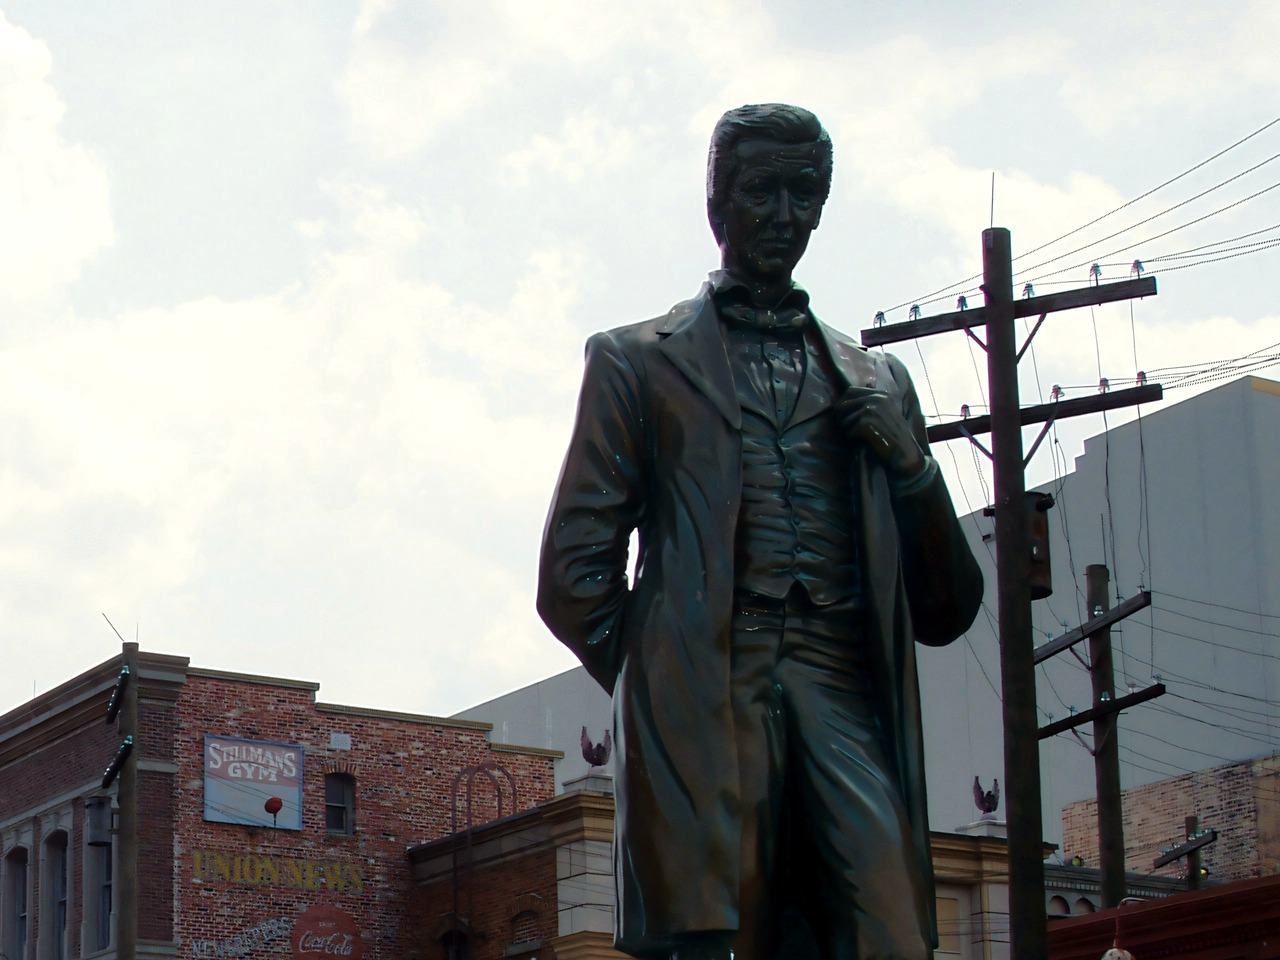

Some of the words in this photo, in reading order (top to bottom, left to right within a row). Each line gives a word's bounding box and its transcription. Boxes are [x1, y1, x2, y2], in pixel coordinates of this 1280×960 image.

[227, 762, 277, 782] GYM
[193, 850, 280, 886] UNION
[287, 859, 364, 894] NEWS
